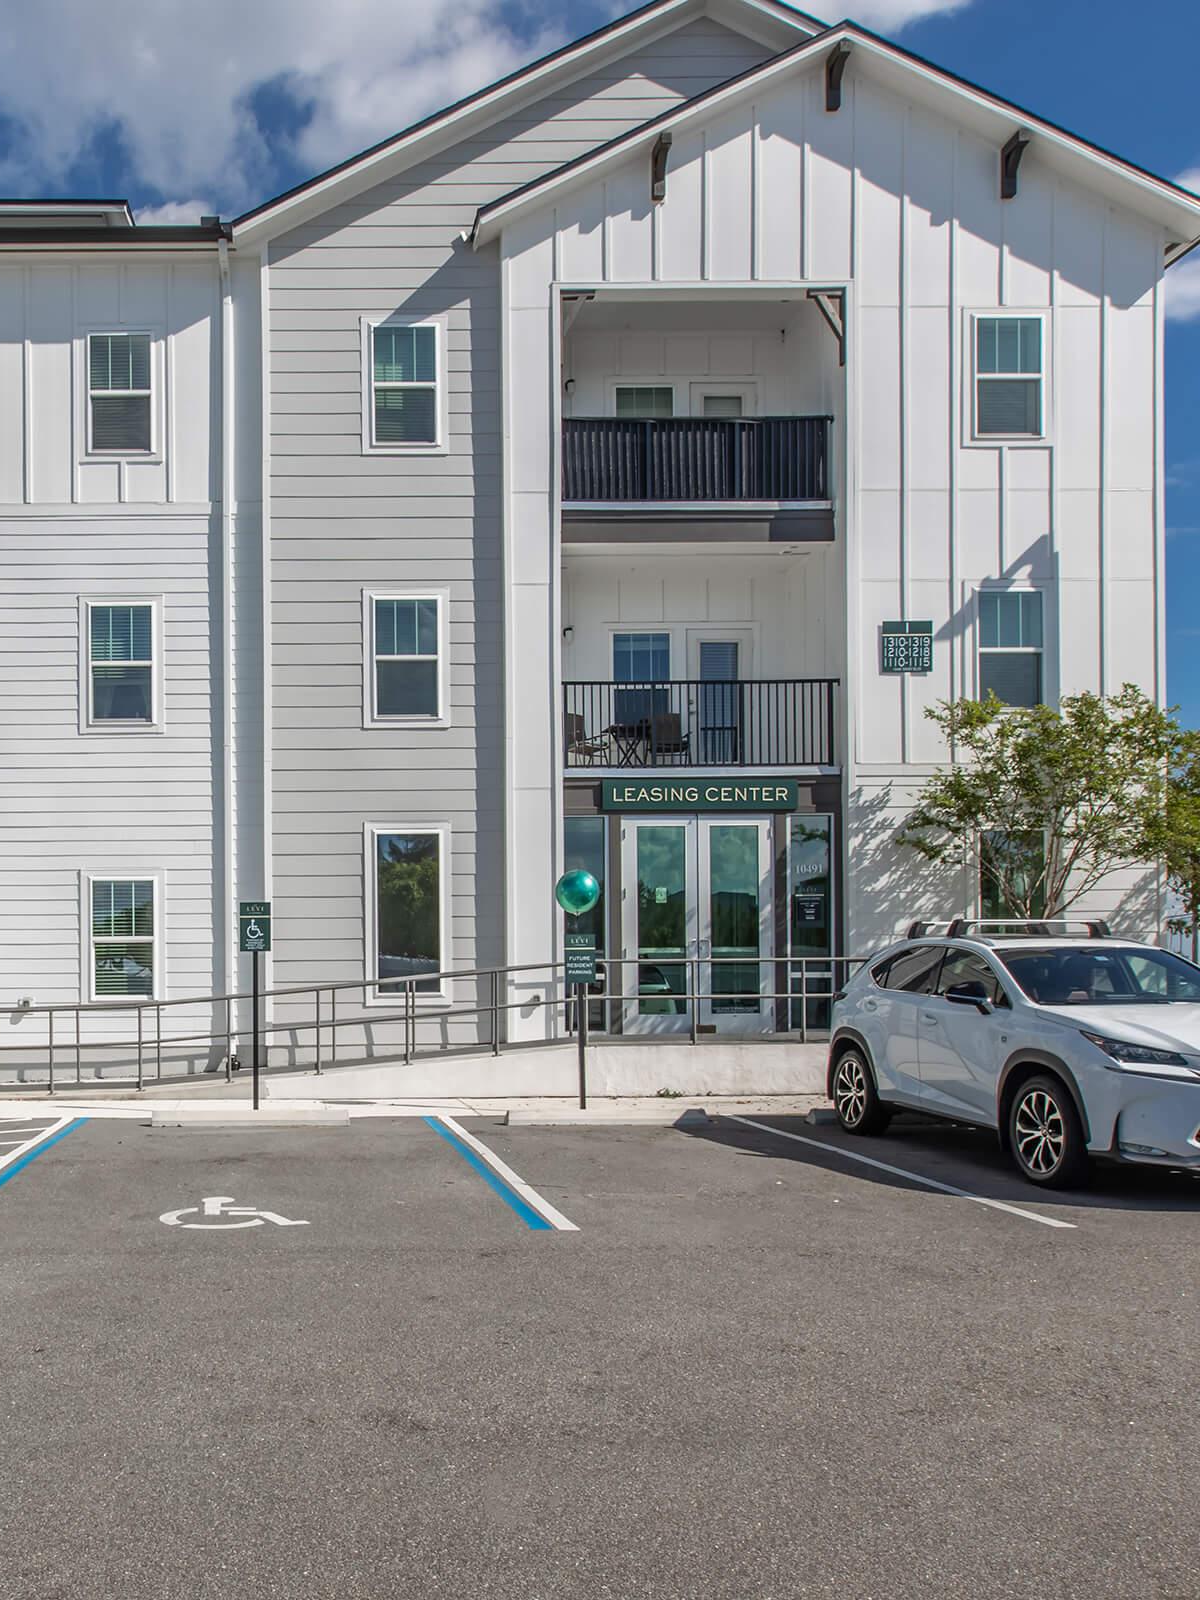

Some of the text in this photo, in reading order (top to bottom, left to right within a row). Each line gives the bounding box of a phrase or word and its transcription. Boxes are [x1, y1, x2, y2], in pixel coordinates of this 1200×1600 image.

[884, 637, 930, 647] 1310-1319
[884, 647, 930, 657] 1210-1218
[884, 657, 930, 667] 1110-1115
[613, 787, 788, 802] LEASING CENTER
